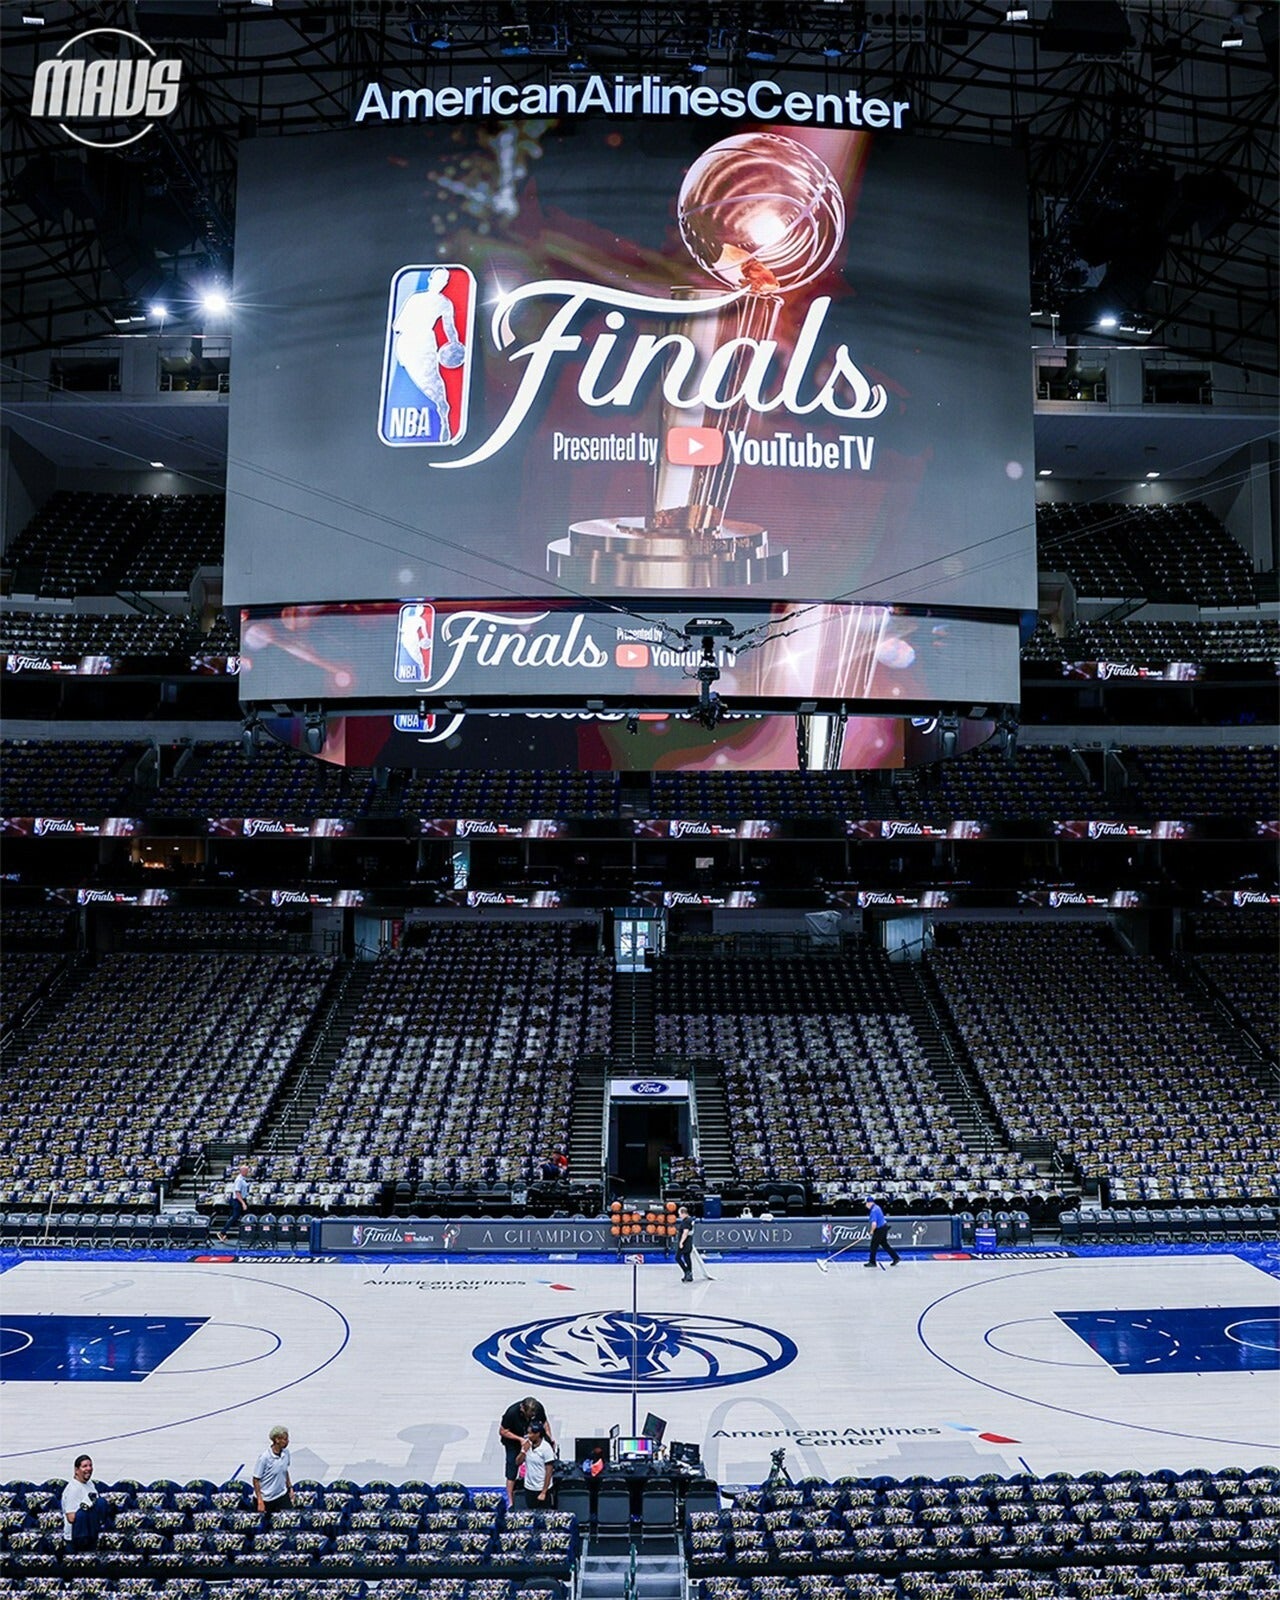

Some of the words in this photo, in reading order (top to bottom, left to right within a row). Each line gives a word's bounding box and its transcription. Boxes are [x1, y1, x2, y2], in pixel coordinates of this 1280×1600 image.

[428, 279, 888, 469] Finals
[388, 407, 431, 438] NBA
[552, 431, 636, 461] Presented
[638, 432, 659, 466] by
[416, 610, 608, 693] Finals
[399, 665, 417, 679] NBA
[42, 819, 76, 837] Finals
[249, 819, 285, 838] Finals
[462, 819, 498, 838] Finals
[675, 820, 712, 839] Finals
[887, 820, 923, 839] Finals
[1094, 820, 1128, 840] Finals
[83, 889, 117, 907] Finals
[276, 890, 310, 907] Finals
[473, 890, 507, 908] Finals
[669, 890, 702, 908] Finals
[863, 890, 897, 908] Finals
[1053, 890, 1087, 907] Finals
[1239, 890, 1271, 907] Finals
[637, 1083, 661, 1093] Ford
[360, 1226, 403, 1248] Finals
[482, 1229, 494, 1243] A
[504, 1229, 606, 1244] CHAMPION
[702, 1229, 793, 1243] CROWNED
[829, 1225, 872, 1247] Finals
[711, 1429, 839, 1439] American
[843, 1426, 941, 1437] Airlines
[795, 1437, 886, 1447] Center
